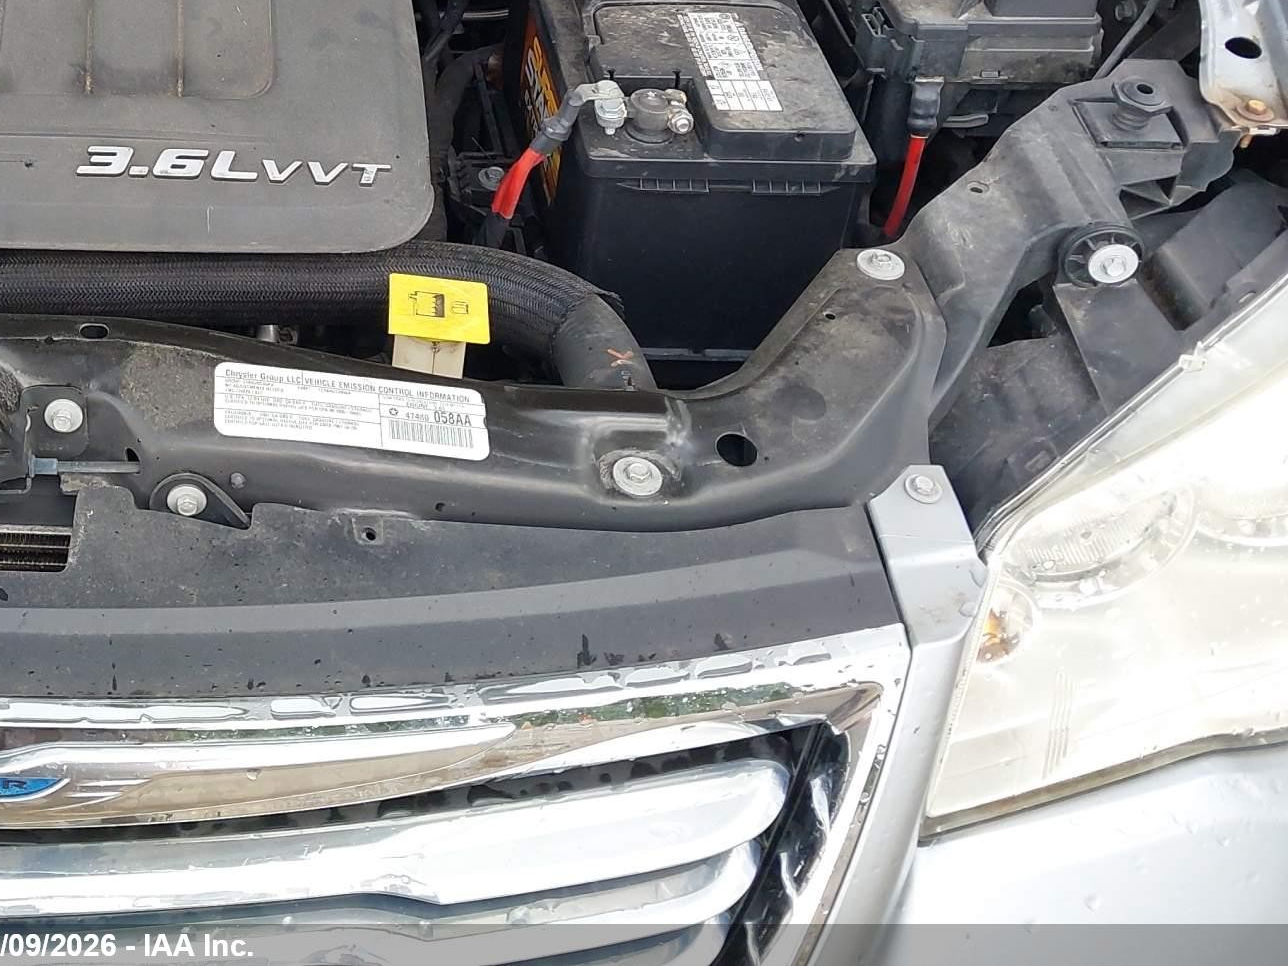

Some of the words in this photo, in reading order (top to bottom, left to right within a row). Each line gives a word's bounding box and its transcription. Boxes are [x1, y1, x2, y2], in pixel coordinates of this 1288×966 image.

[75, 145, 258, 181] 3.6L
[262, 159, 392, 187] VVT
[225, 369, 258, 380] Chrysler
[260, 372, 284, 383] Group
[286, 376, 302, 384] LLC
[304, 377, 336, 388] VEHICLE
[338, 381, 376, 392] EMISSION
[378, 386, 413, 396] CONTROL
[416, 390, 470, 403] INFORMATION
[433, 410, 472, 426] 058AA
